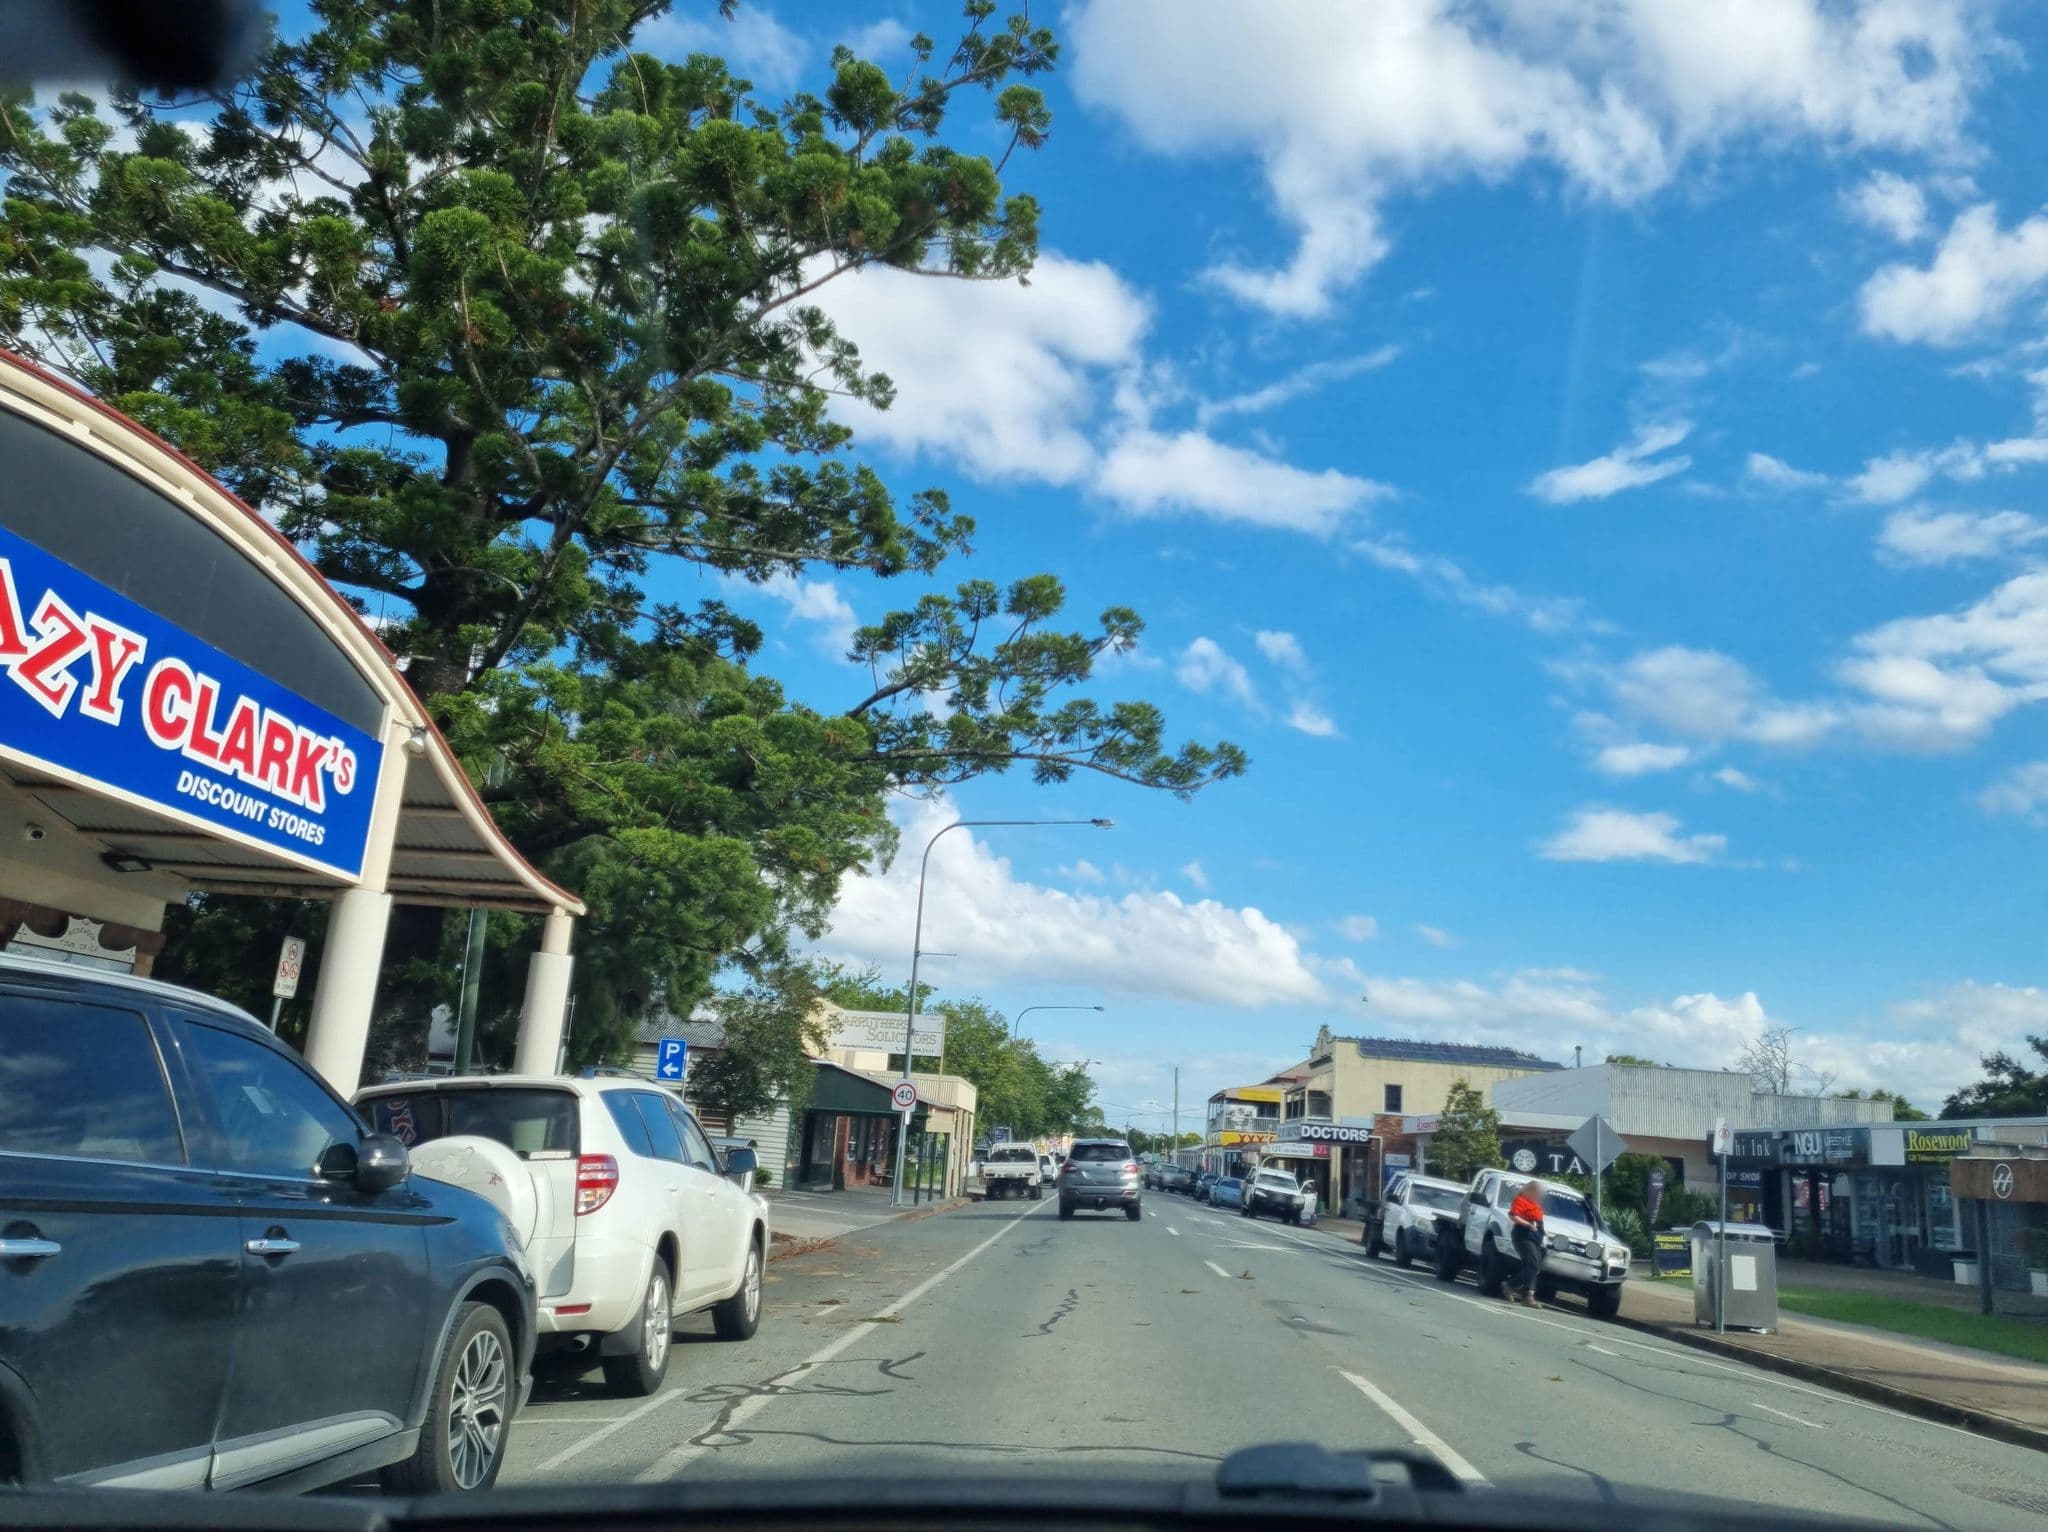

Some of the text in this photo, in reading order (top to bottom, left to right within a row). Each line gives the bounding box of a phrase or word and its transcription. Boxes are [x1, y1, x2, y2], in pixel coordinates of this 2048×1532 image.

[142, 657, 357, 815] CLARK'S
[177, 771, 326, 846] DISCOUNT STORES
[866, 1027, 937, 1046] SOLICIORS
[666, 1042, 680, 1060] P
[897, 1090, 912, 1101] 40
[1301, 1125, 1369, 1142] DOCTORS
[1908, 1128, 1971, 1151] Rosewood
[1794, 1133, 1820, 1156] NGU
